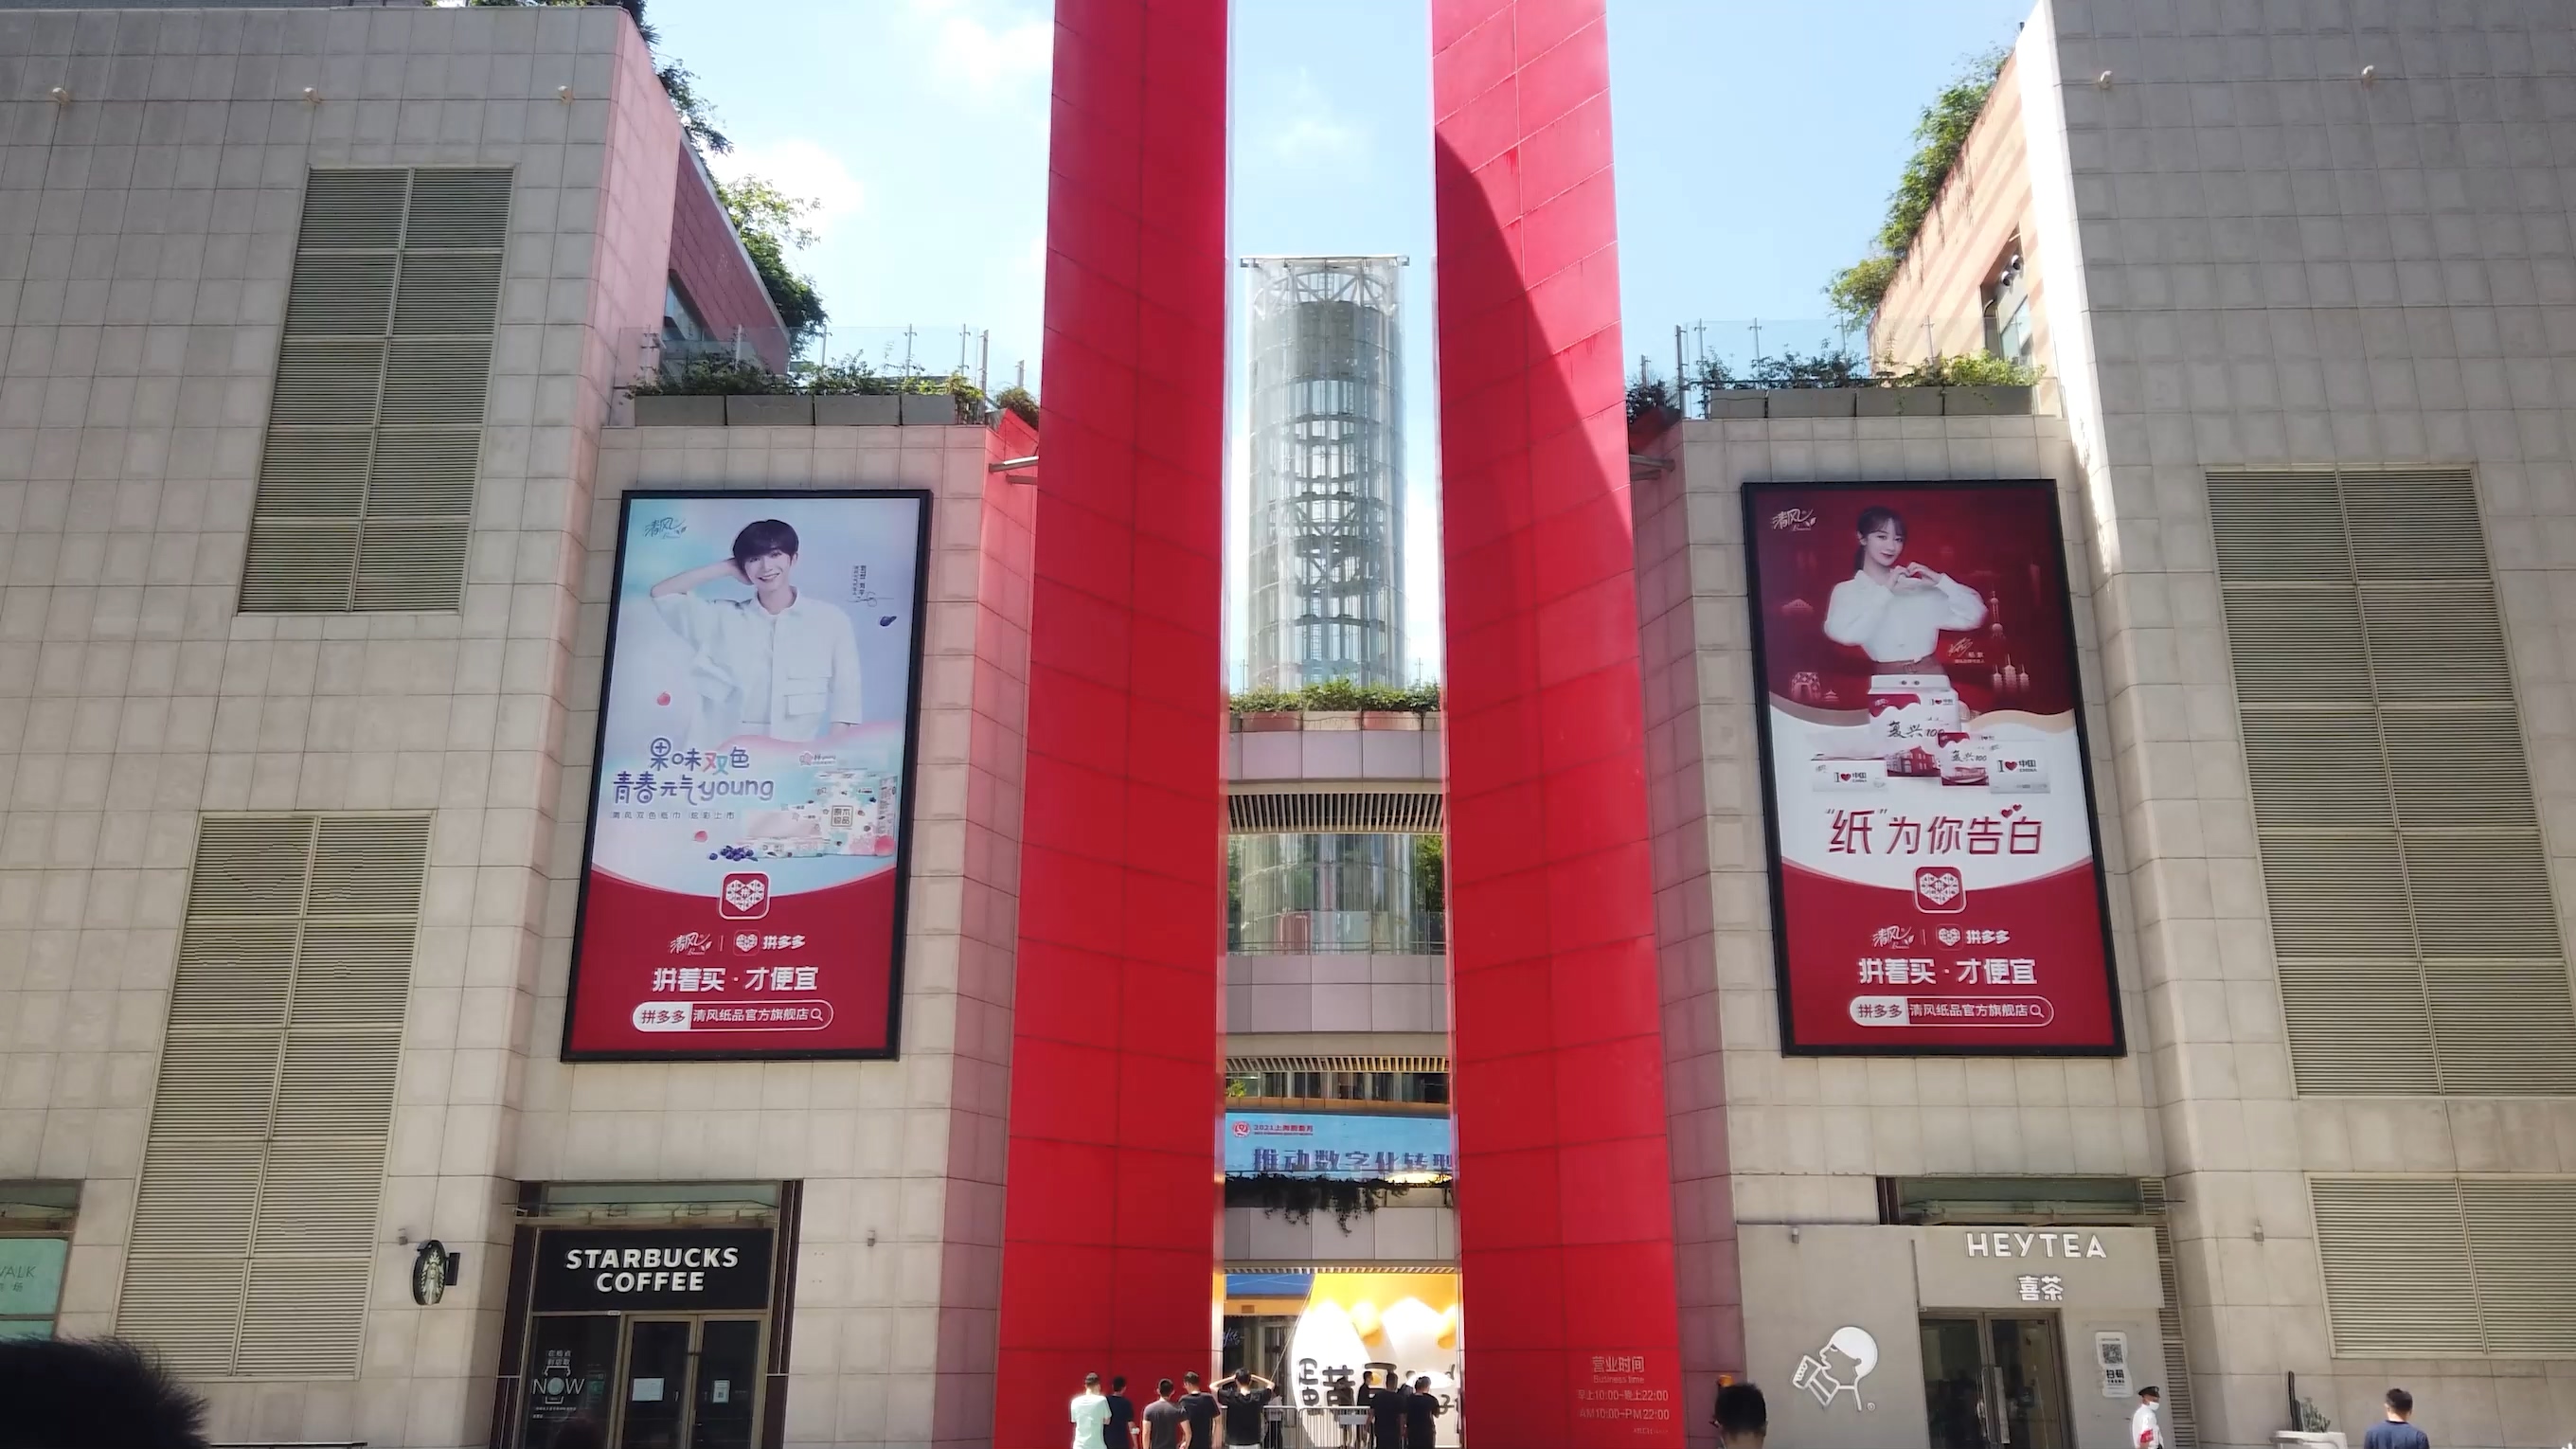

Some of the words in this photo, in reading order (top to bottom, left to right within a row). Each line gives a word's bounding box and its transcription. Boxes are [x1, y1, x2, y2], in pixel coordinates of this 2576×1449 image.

[650, 737, 751, 776] 果味双色
[762, 934, 806, 950] 拼多多
[1965, 929, 2011, 945] 拼多多
[641, 1009, 687, 1025] 拼多多
[692, 1007, 810, 1023] 清风纸品官方旗舰店
[1857, 1003, 1904, 1019] 拼多多
[1909, 1003, 2029, 1018] 清风纸品官方旗舰店
[1965, 1232, 2108, 1259] HEYTEA
[565, 1246, 739, 1270] STARBUCKS
[596, 1271, 707, 1294] COFFEE
[2017, 1274, 2065, 1302] 喜茶
[1592, 1355, 1645, 1373] 营业时间
[1593, 1374, 1627, 1384] Business
[1628, 1375, 1645, 1384] time
